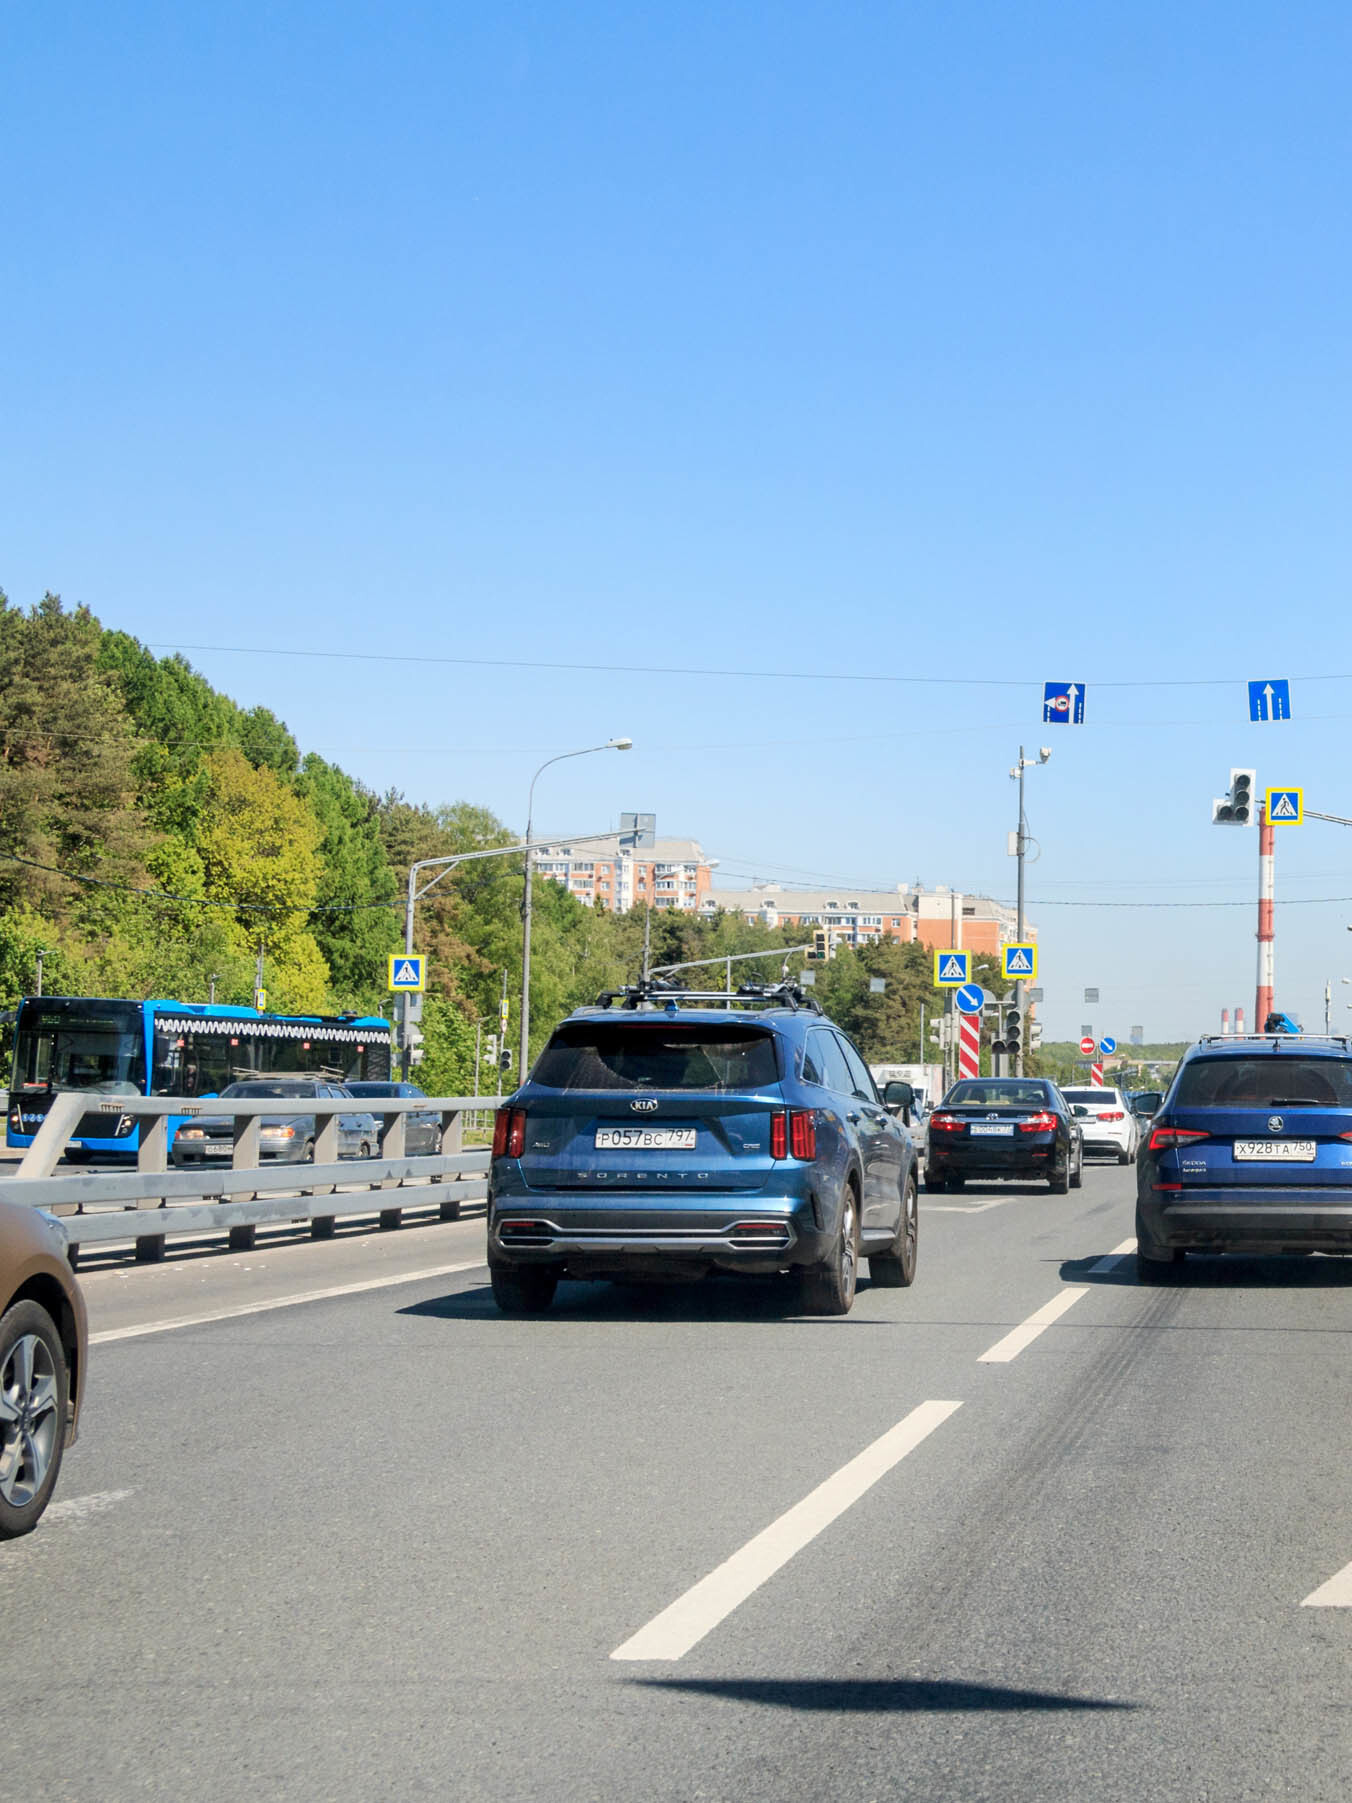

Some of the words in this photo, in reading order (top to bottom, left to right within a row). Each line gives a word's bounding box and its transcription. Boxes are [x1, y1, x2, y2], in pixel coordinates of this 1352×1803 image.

[633, 1100, 655, 1110] KIA
[600, 1129, 663, 1146] Р057ВС
[668, 1128, 692, 1142] 797
[1238, 1141, 1290, 1154] Х928ТА
[1293, 1141, 1313, 1152] 750
